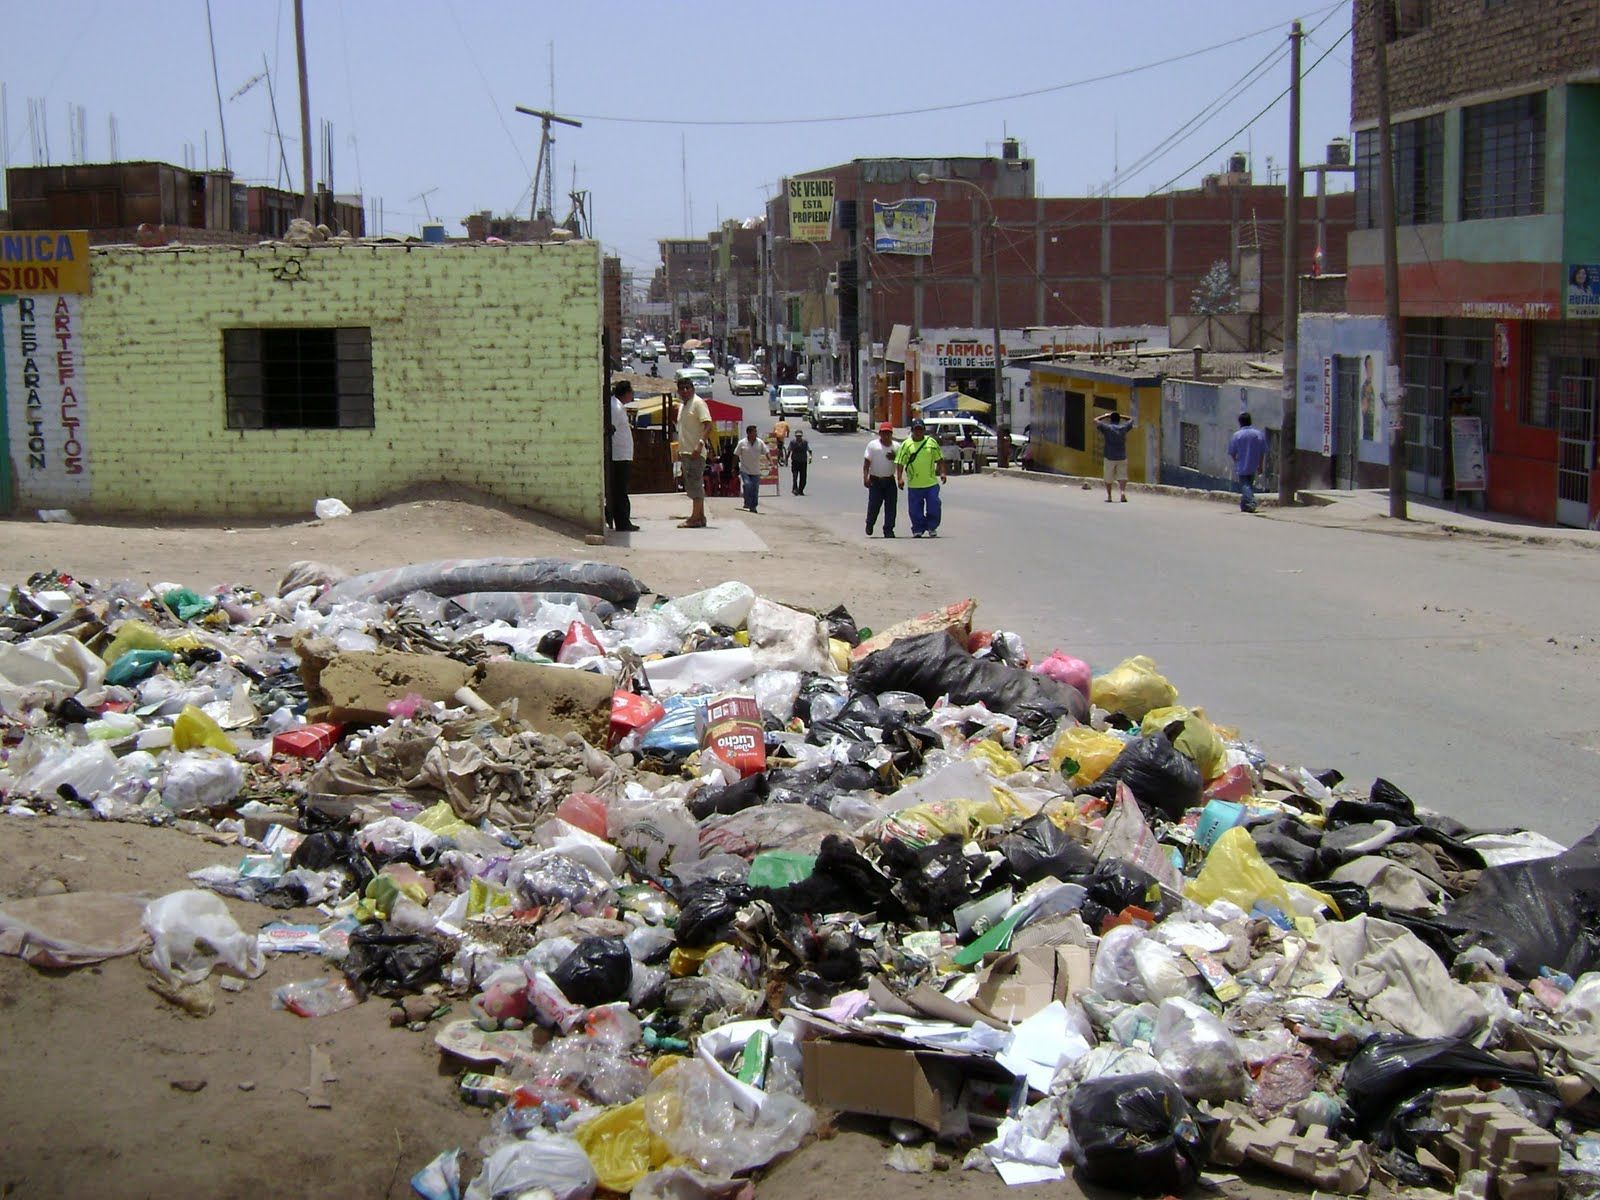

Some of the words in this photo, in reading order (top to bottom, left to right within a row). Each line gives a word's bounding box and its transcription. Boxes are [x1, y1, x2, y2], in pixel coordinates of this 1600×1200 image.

[790, 181, 802, 198] SE
[803, 180, 834, 197] VENDE
[802, 199, 823, 209] ESTA
[0, 233, 75, 262] NICA
[936, 344, 1008, 356] FARMACA
[966, 357, 976, 367] DE
[19, 298, 47, 470] REPARACION
[55, 296, 84, 475] ARTEFACTOS
[717, 735, 756, 748] Lucho
